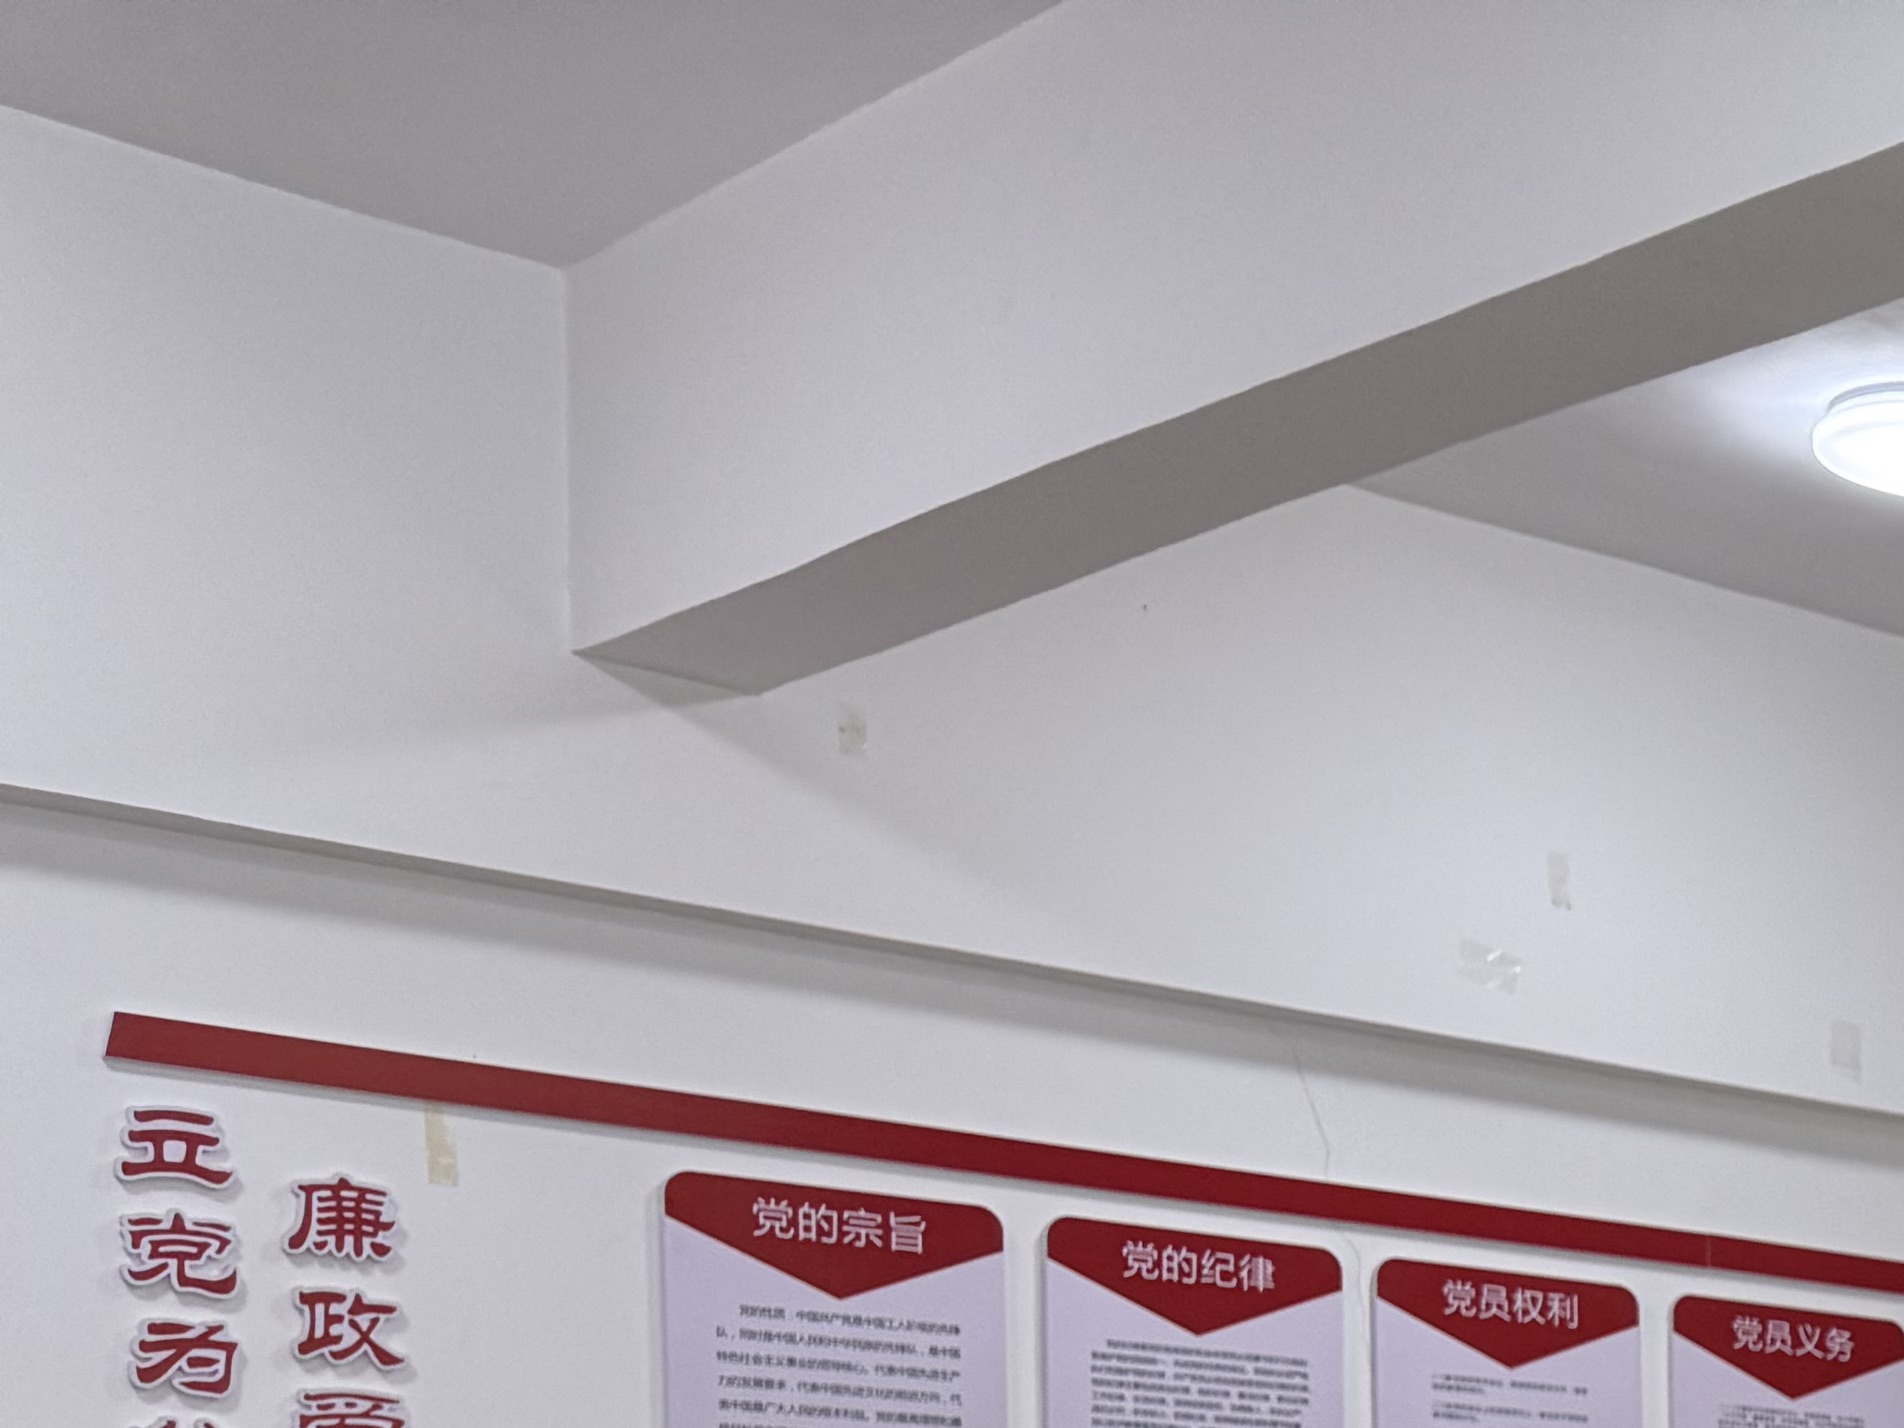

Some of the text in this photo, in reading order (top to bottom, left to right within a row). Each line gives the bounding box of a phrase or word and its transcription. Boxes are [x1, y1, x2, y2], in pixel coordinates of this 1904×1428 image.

[752, 1196, 926, 1254] 党的宗旨
[1122, 1240, 1275, 1293] 党的纪律
[1442, 1278, 1580, 1329] 党员权利
[1732, 1316, 1855, 1362] 党员义务
